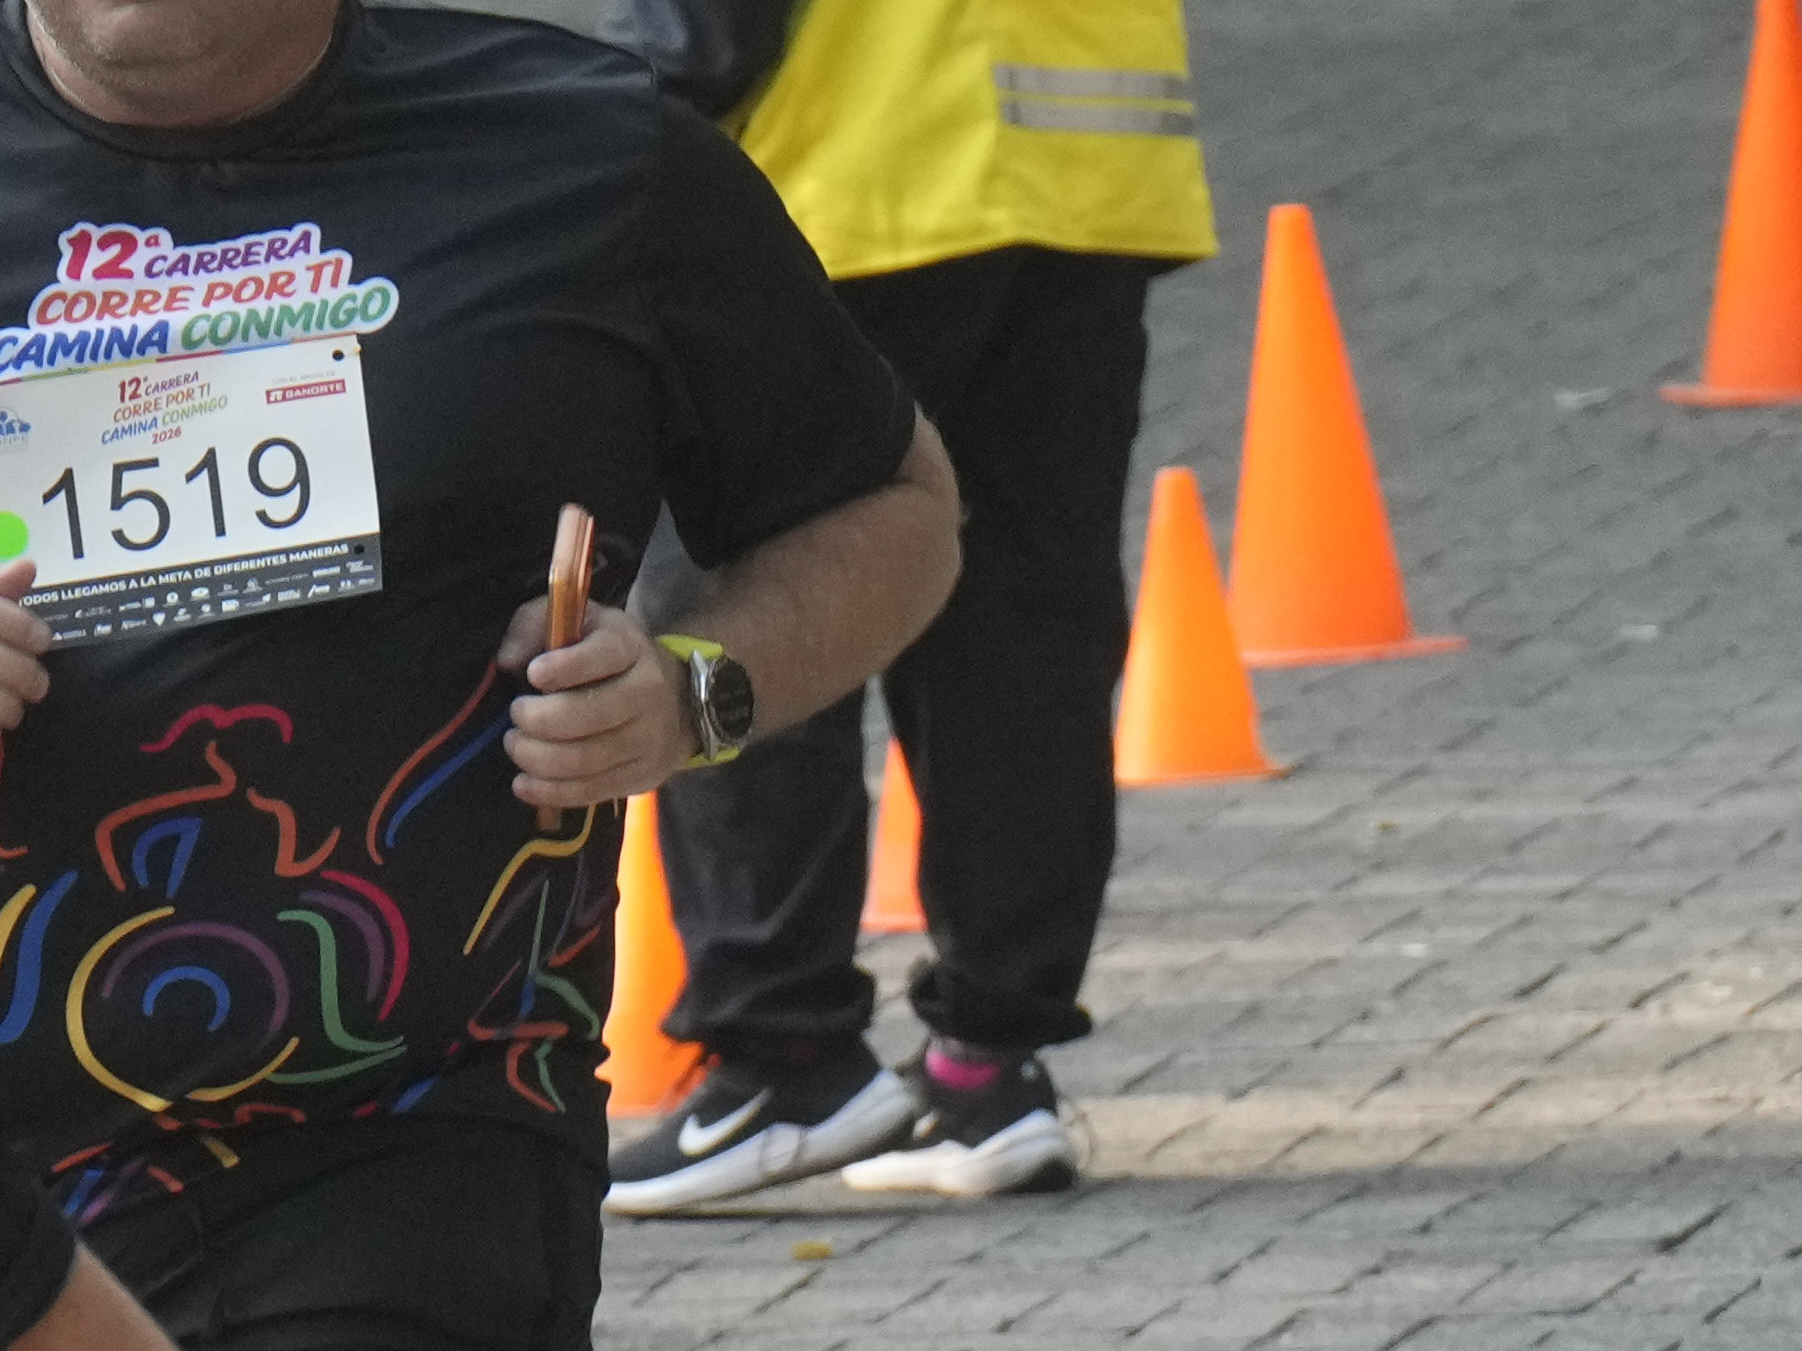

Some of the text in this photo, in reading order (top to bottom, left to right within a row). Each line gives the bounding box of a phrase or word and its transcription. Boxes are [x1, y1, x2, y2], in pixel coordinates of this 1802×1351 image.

[144, 229, 312, 279] CARRERA
[36, 256, 344, 326] CORRE POR TI
[181, 285, 392, 351] CONMIGO
[113, 382, 211, 423] CORRE POR TI
[144, 370, 199, 397] CARRERA
[285, 382, 344, 399] BANORTE
[101, 394, 229, 445] CAMINA CONMIGO
[151, 426, 183, 445] 2026
[42, 436, 311, 560] 1519
[61, 579, 127, 600] LLEGAMOS
[129, 578, 139, 591] A
[140, 575, 157, 588] LA
[158, 569, 193, 585] META
[194, 566, 211, 579] DE
[213, 552, 288, 576] DIFERENTES
[289, 543, 349, 563] MANERAS
